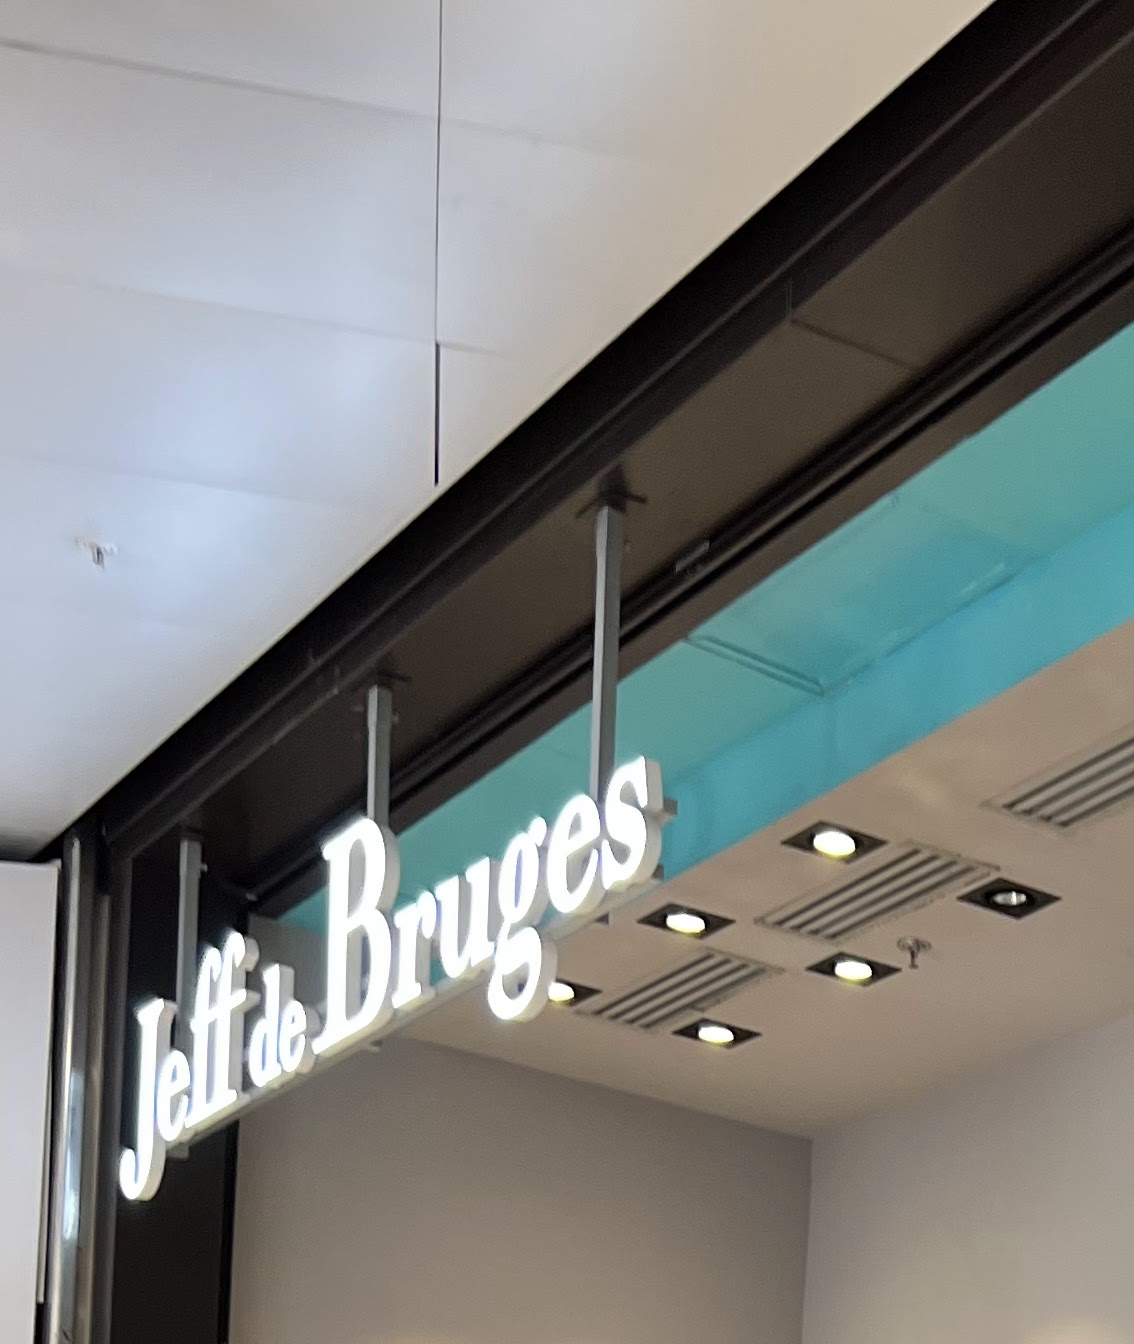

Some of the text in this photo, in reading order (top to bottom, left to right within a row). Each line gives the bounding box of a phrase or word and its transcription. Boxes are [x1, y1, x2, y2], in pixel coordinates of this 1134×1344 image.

[118, 754, 662, 1202] Jeff de Bruges
